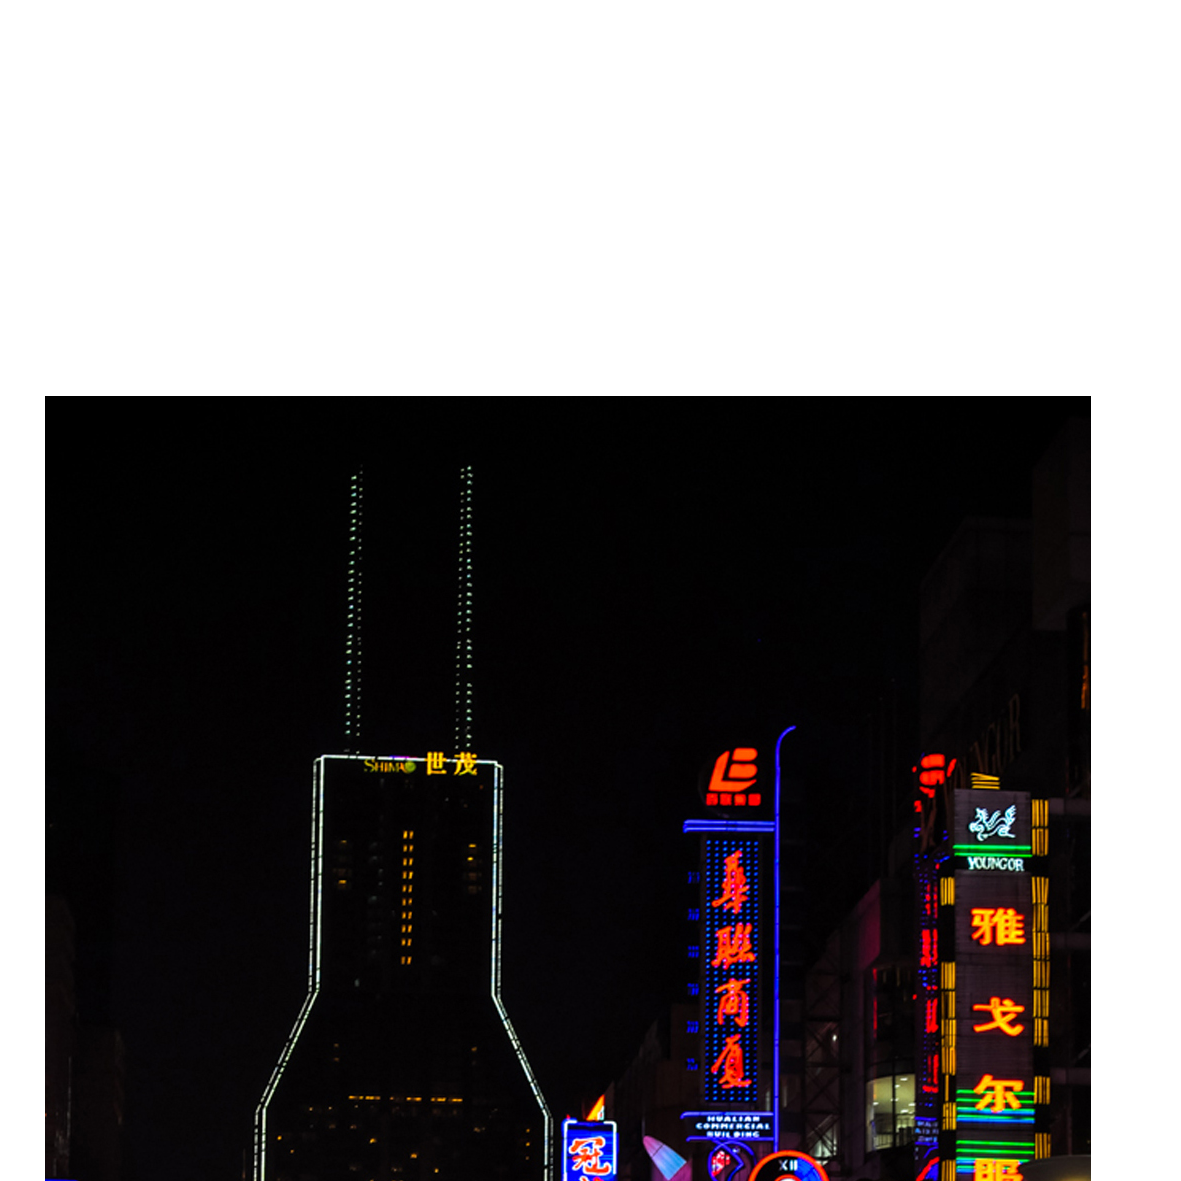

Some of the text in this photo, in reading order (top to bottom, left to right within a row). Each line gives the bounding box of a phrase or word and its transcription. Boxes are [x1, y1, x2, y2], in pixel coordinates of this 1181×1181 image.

[425, 751, 478, 776] 世茂
[967, 856, 1025, 872] YOUNGOR
[706, 1115, 761, 1123] HUALIAN
[695, 1122, 771, 1130] COMMERCIAL
[778, 1159, 799, 1171] XII
